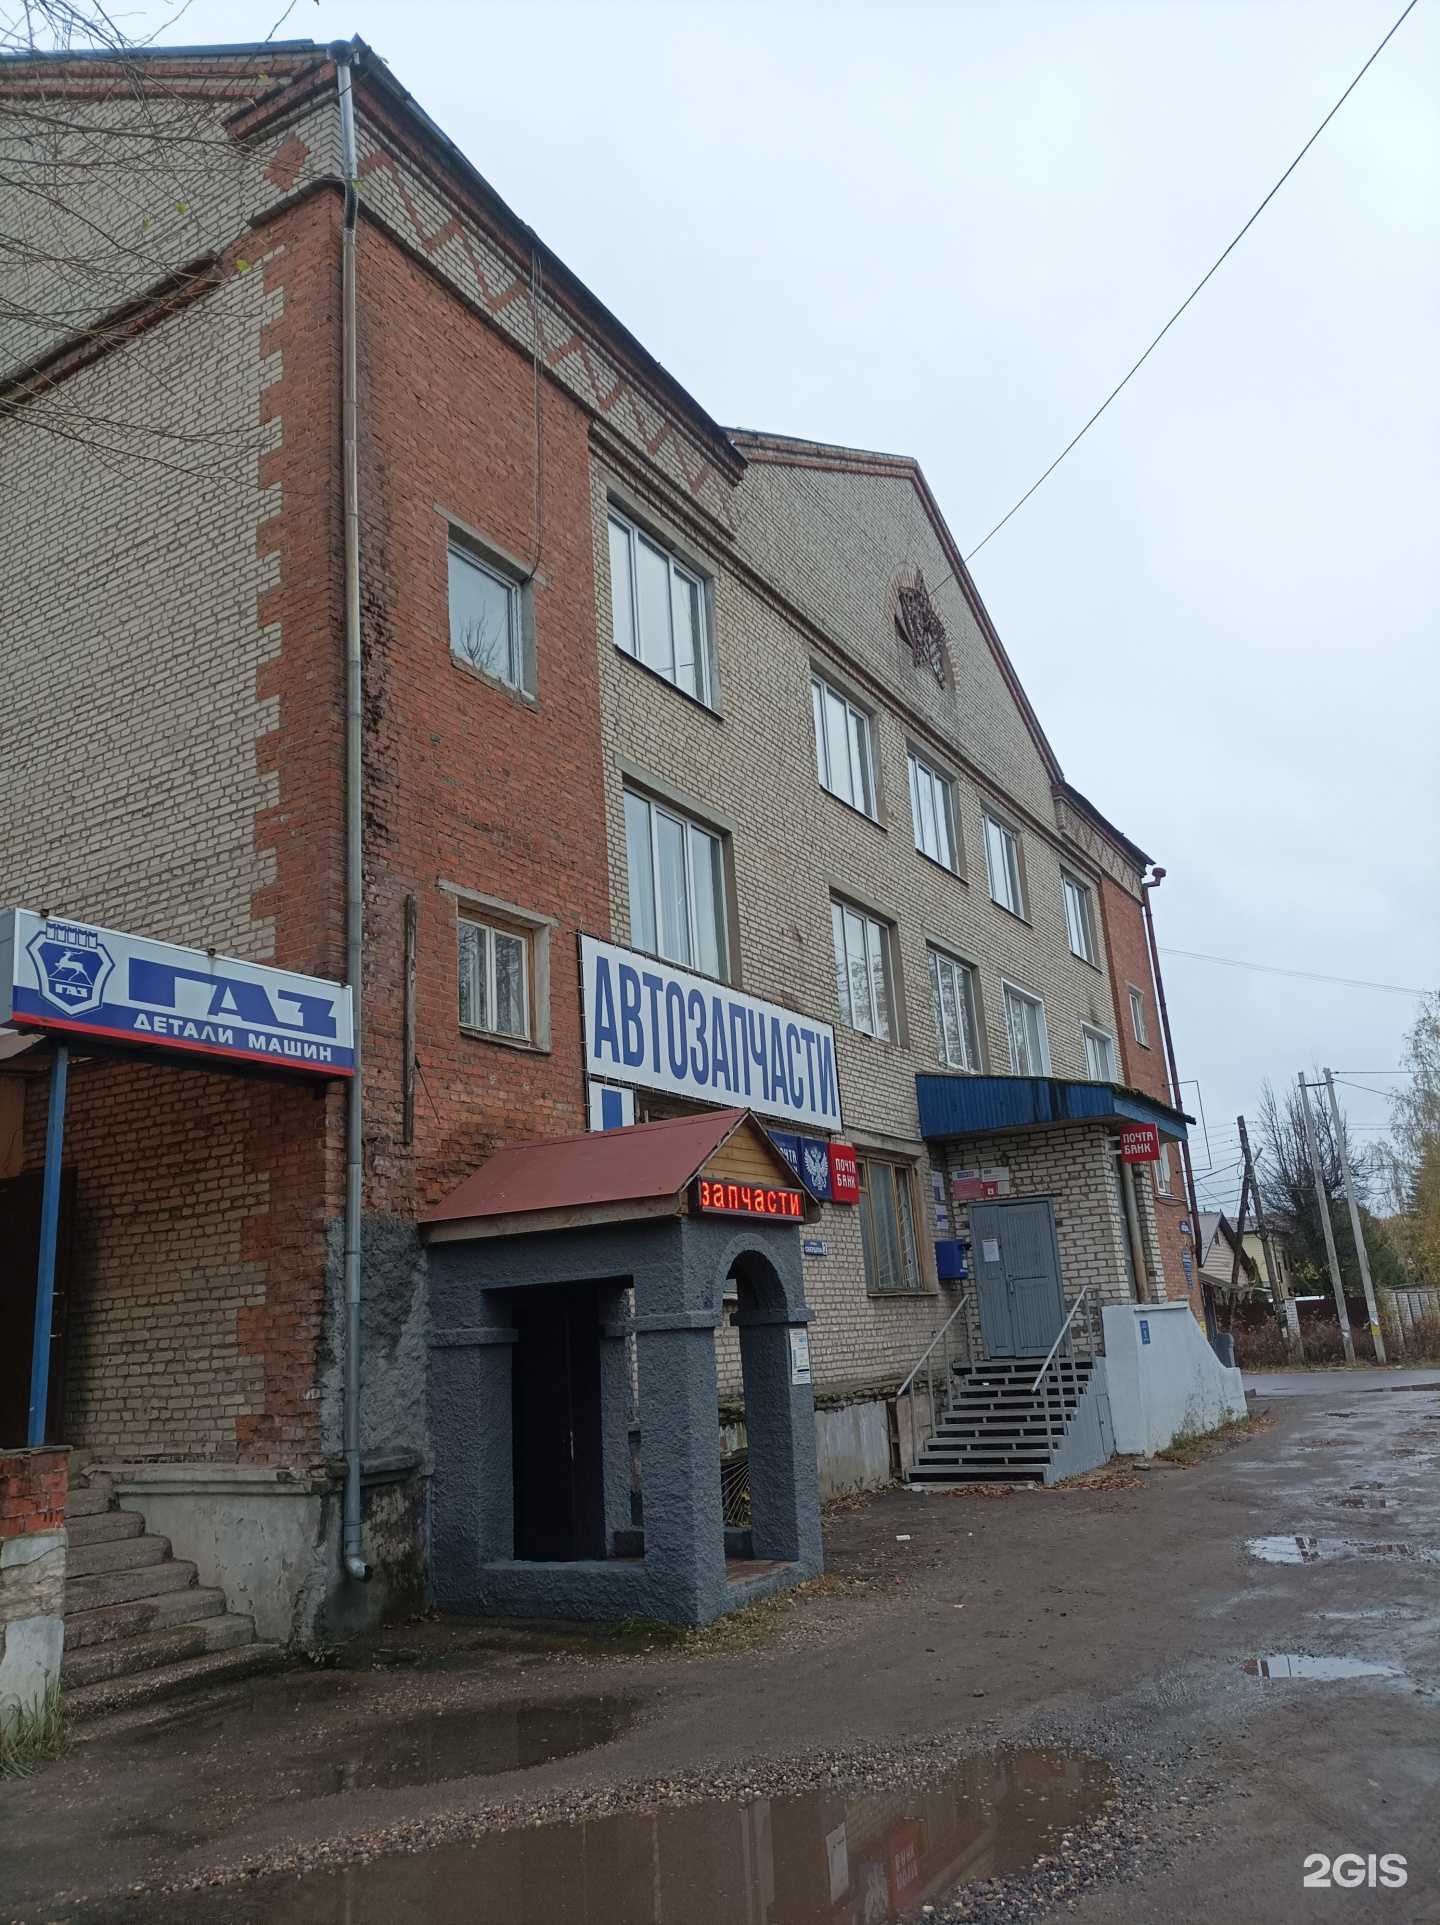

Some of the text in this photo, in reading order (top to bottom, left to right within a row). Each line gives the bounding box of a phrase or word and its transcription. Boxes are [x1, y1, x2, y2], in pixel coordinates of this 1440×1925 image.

[55, 983, 88, 998] ГАЗ
[129, 957, 336, 1038] ГАЗ
[133, 1013, 332, 1062] ДЕТАЛИ МАШИН
[594, 956, 837, 1117] АВТОЗАПЧАСТИ
[1122, 1131, 1154, 1143] ПОЧТА
[1124, 1143, 1151, 1154] БАНК
[835, 1158, 856, 1173] ПОЧТА
[836, 1174, 856, 1188] БАНК
